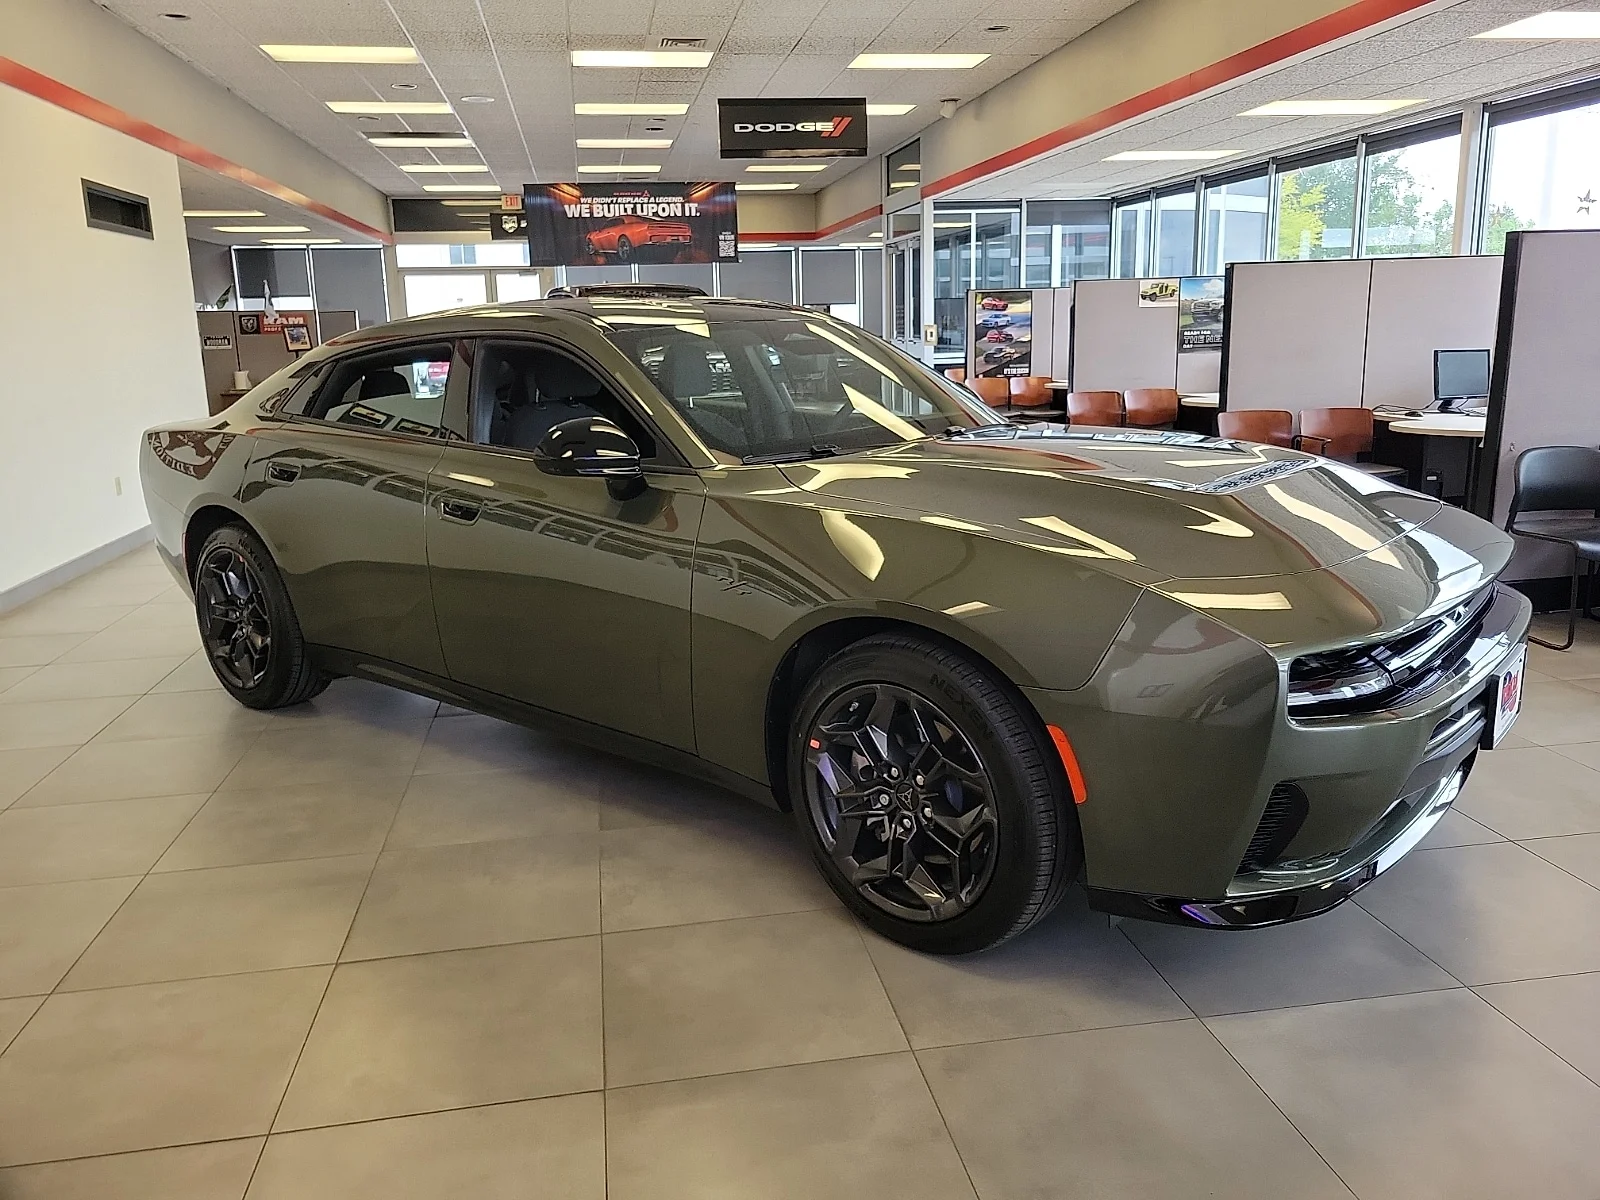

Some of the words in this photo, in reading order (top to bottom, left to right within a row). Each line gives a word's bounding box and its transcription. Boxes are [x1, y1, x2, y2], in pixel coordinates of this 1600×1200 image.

[734, 122, 834, 132] DODGE
[505, 196, 519, 207] EXIT
[617, 196, 649, 204] REPLACE
[564, 203, 591, 218] WE
[592, 203, 634, 218] BUILT
[635, 202, 682, 217] UPON
[684, 203, 701, 217] IT.
[1183, 335, 1205, 344] THE
